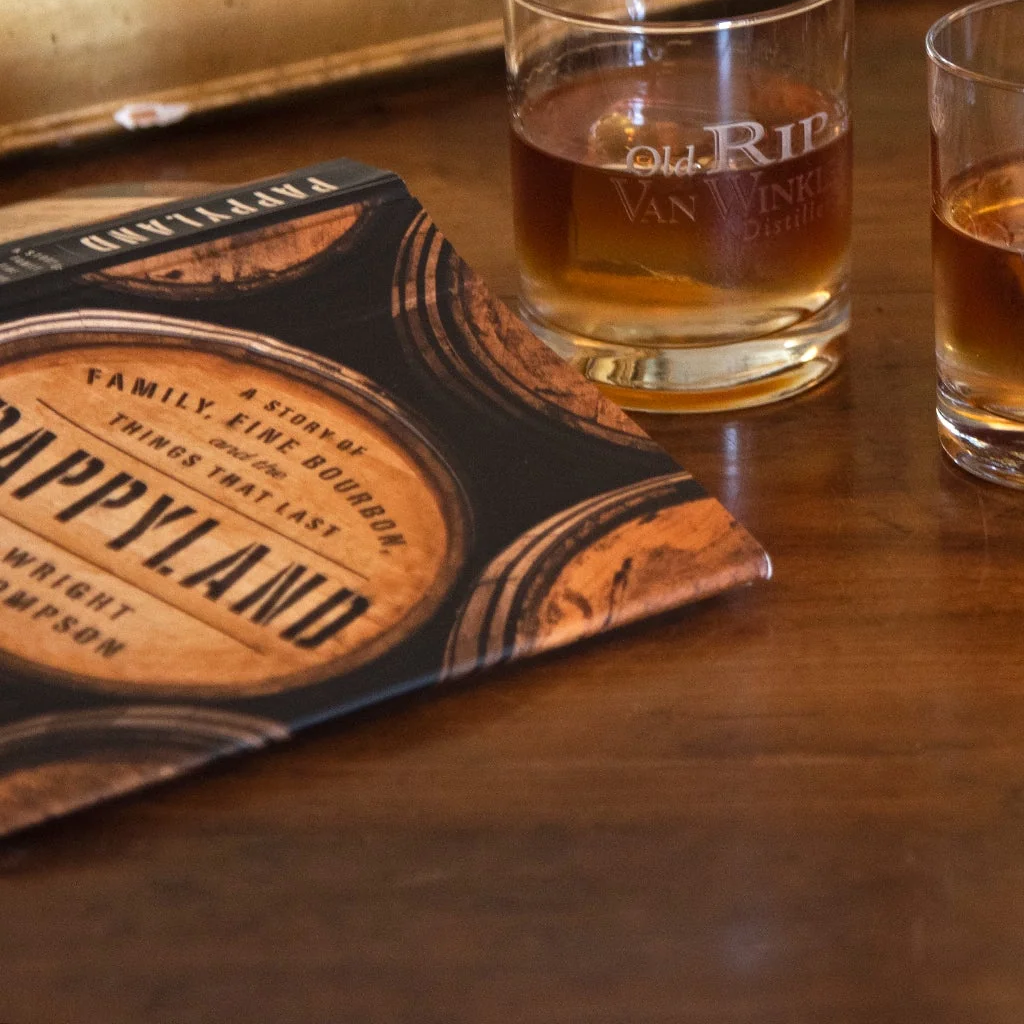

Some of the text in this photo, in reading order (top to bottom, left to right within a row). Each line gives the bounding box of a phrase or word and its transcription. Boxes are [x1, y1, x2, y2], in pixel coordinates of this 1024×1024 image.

[626, 111, 829, 177] Old RIP
[79, 176, 340, 253] PAPPYLAND
[609, 176, 698, 224] VAN
[239, 387, 368, 456] A STORY OF
[85, 367, 408, 556] FAMILY, FINE BOURBON,
[107, 411, 342, 538] THINGS THAT LAST
[208, 437, 288, 479] and the
[1, 547, 136, 621] WRIGHT
